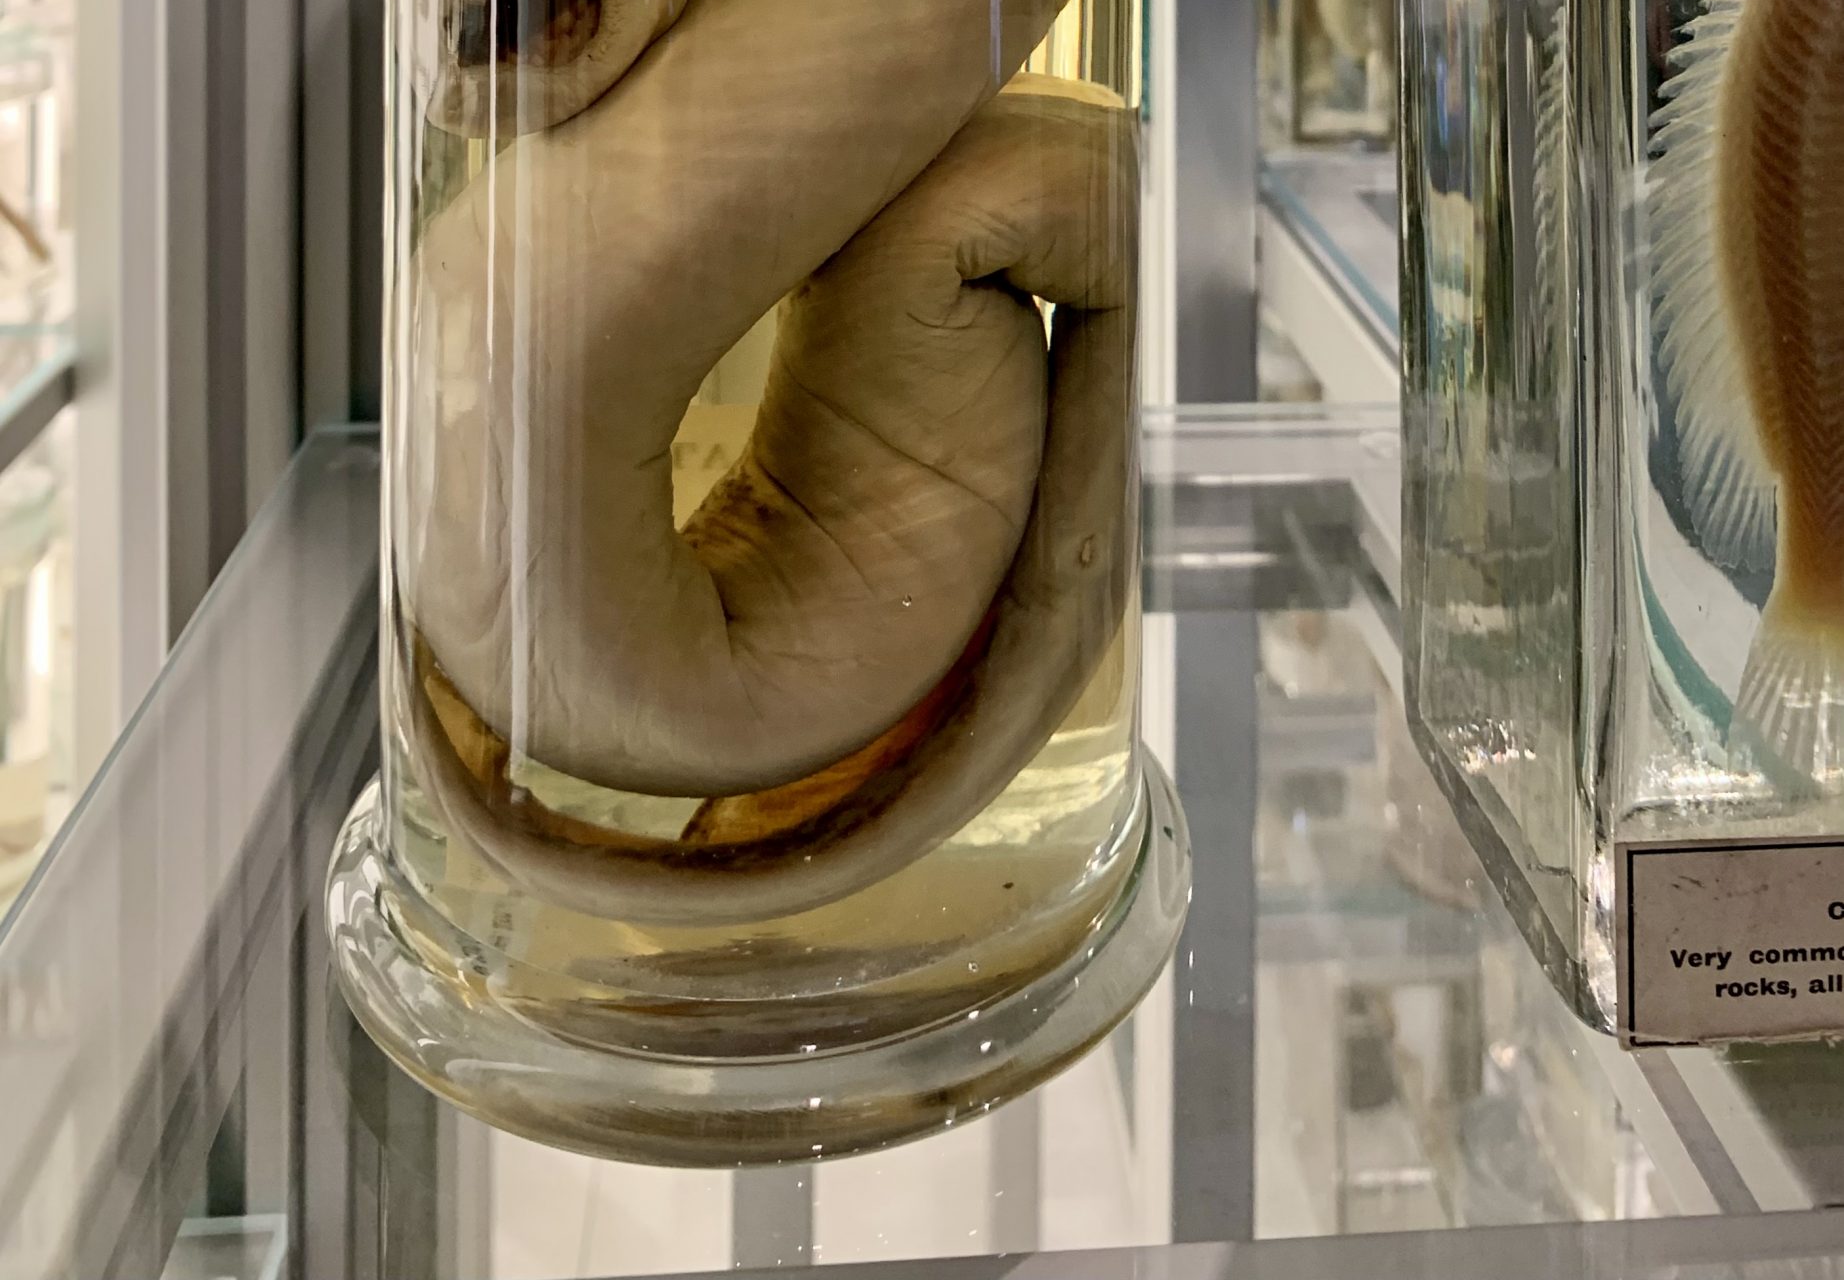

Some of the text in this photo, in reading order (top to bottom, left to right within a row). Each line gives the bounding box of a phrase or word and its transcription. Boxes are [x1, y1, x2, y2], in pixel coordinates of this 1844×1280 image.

[1670, 949, 1732, 970] Very
[1715, 973, 1843, 999] rocks, all
